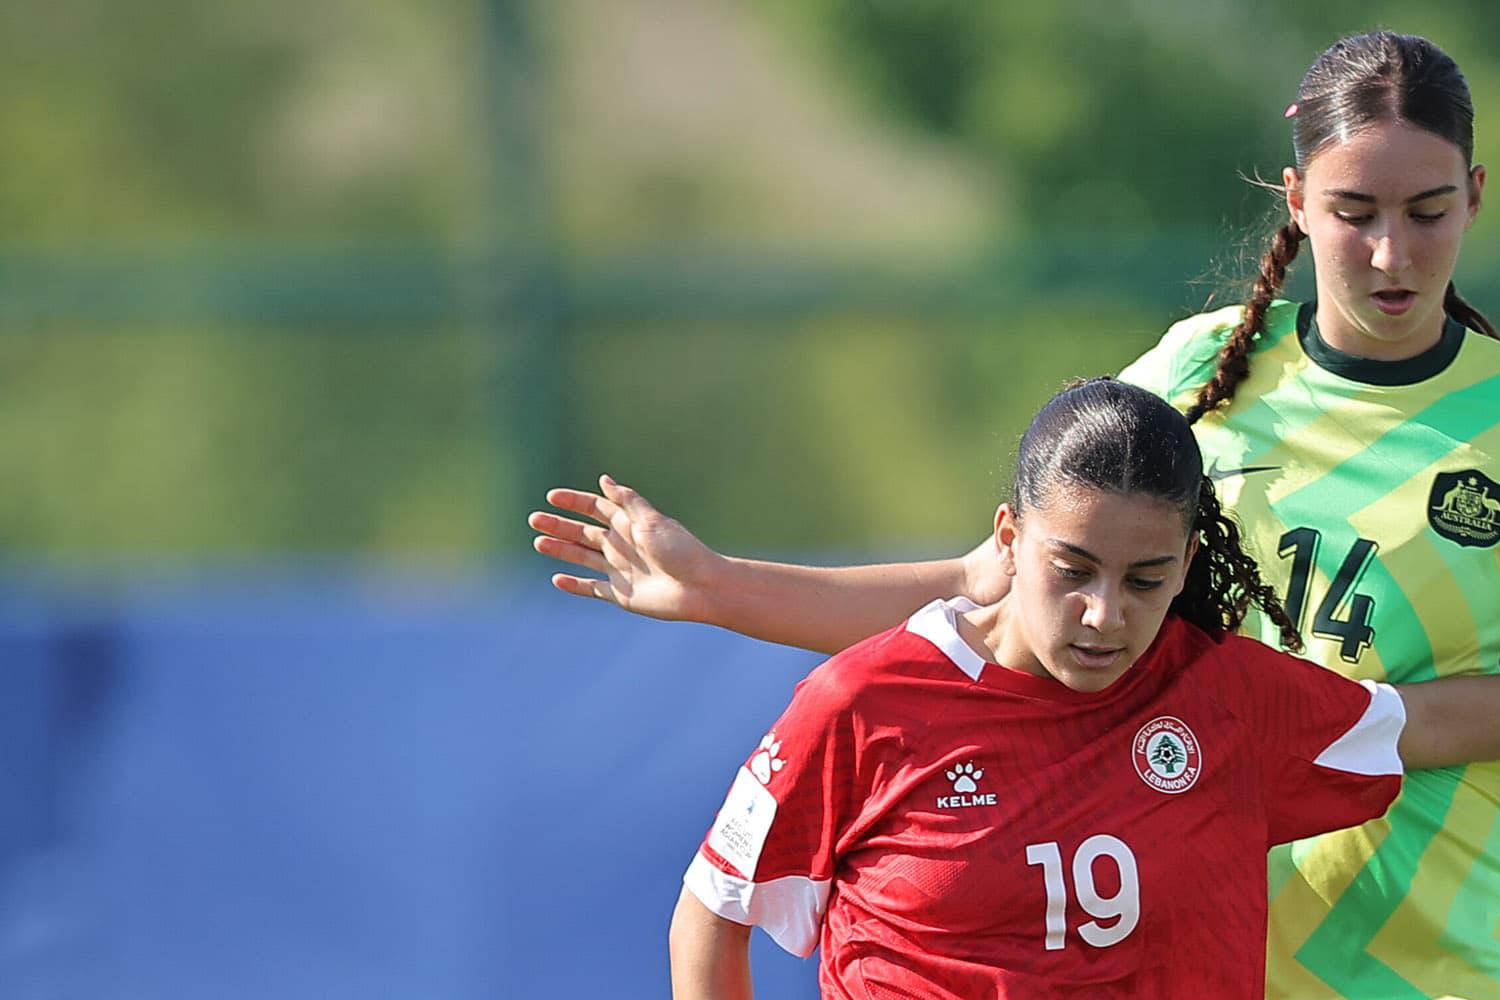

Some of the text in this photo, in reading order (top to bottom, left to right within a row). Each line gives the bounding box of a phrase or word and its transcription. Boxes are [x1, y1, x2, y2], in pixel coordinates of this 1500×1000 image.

[1440, 512, 1492, 531] AUSTRALIA
[1277, 526, 1380, 664] 14
[1143, 768, 1188, 790] LEBANON
[937, 793, 997, 809] KELME
[1026, 834, 1140, 950] 19
